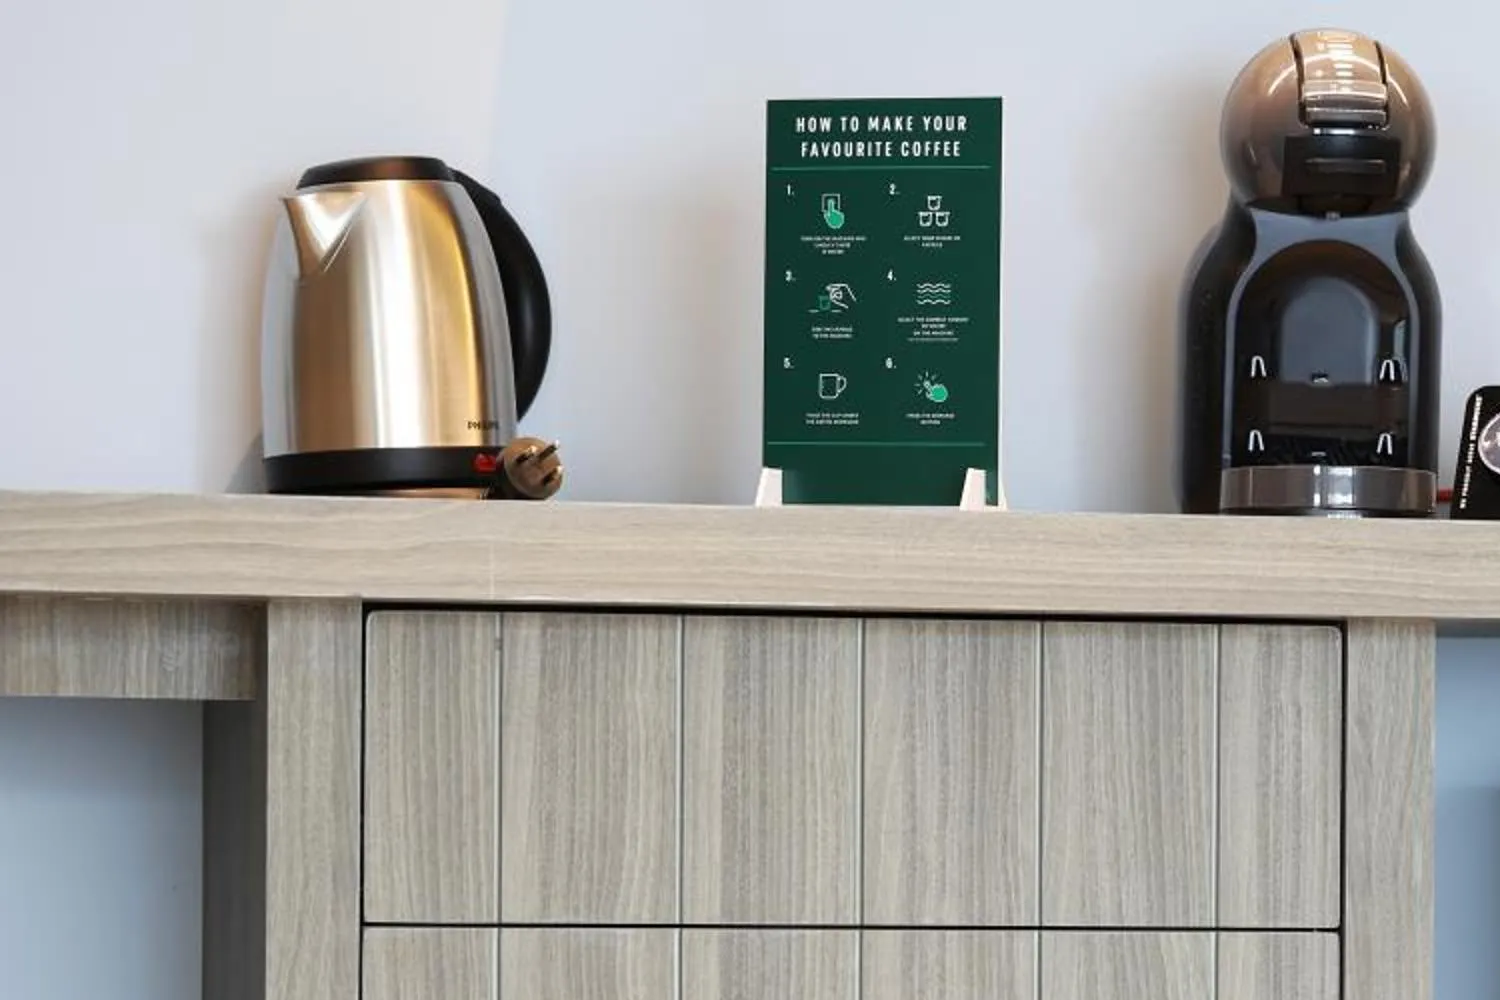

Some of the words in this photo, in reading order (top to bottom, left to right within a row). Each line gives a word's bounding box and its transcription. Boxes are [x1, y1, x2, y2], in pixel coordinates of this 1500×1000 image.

[796, 116, 832, 133] HOW
[840, 115, 860, 132] TO
[867, 115, 914, 132] MAKE
[922, 115, 968, 132] YOUR
[801, 141, 893, 158] FAVOURITE
[900, 140, 961, 157] COFFEE
